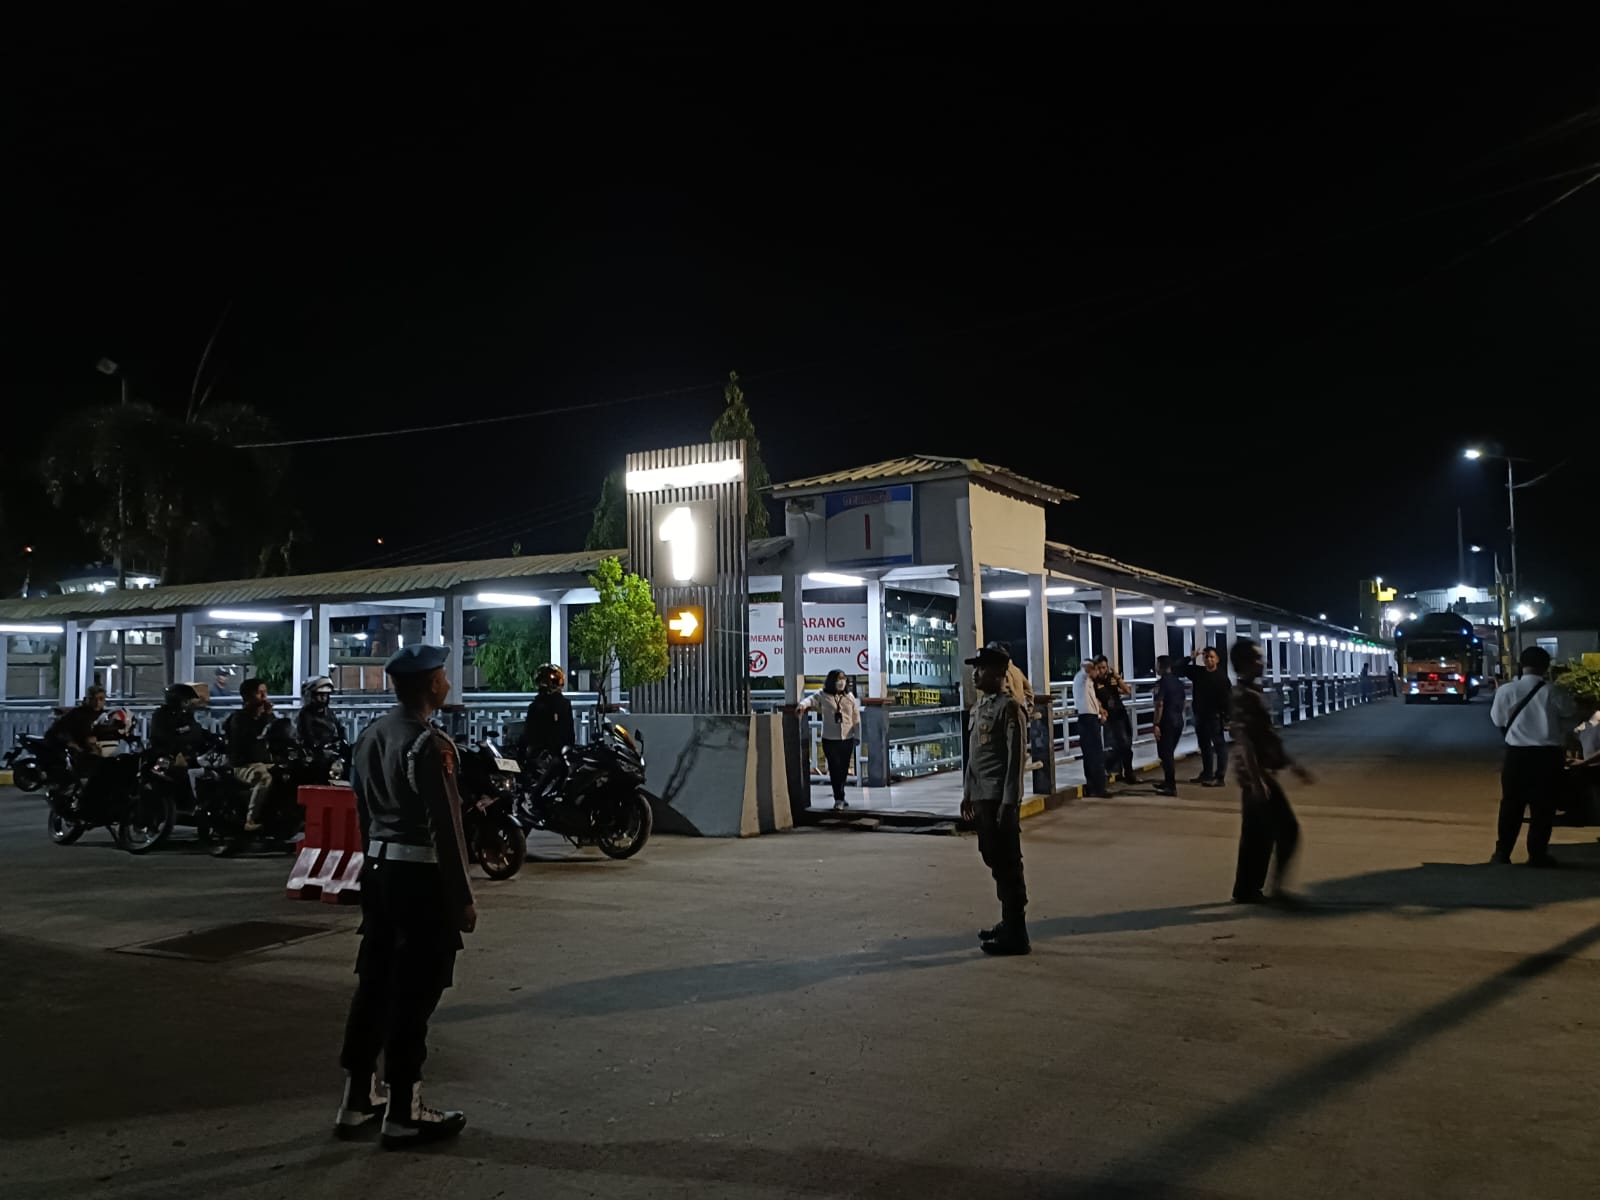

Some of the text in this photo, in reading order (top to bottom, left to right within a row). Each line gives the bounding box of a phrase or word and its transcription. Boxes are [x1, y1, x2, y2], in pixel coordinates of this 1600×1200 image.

[659, 507, 696, 581] 1
[778, 617, 845, 628] DARANG
[806, 634, 825, 642] DAN
[828, 634, 867, 642] BERENAN
[809, 647, 851, 655] PERAIRAN
